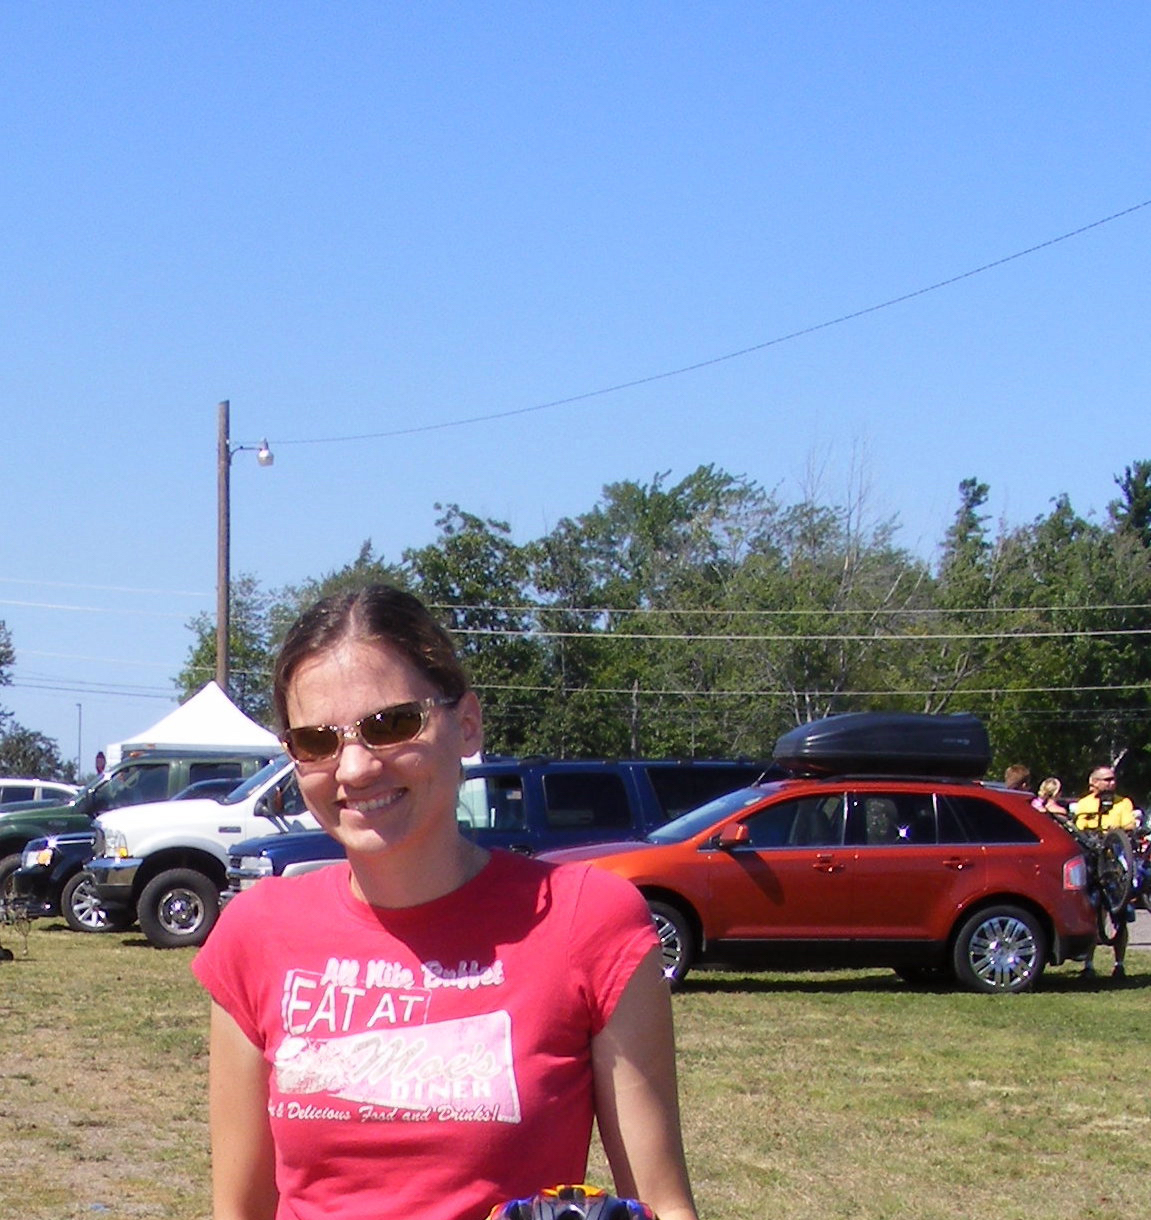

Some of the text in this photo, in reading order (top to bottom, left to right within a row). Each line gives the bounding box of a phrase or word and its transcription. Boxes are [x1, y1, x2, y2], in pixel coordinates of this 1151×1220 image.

[320, 957, 505, 990] All Nite Buffet
[287, 976, 425, 1036] EAT AT
[350, 1034, 501, 1085] Moe's
[391, 1079, 492, 1101] DINER
[287, 1101, 351, 1121] Delicious
[359, 1104, 398, 1122] Food
[402, 1104, 432, 1121] and
[436, 1103, 500, 1122] Drinks!
